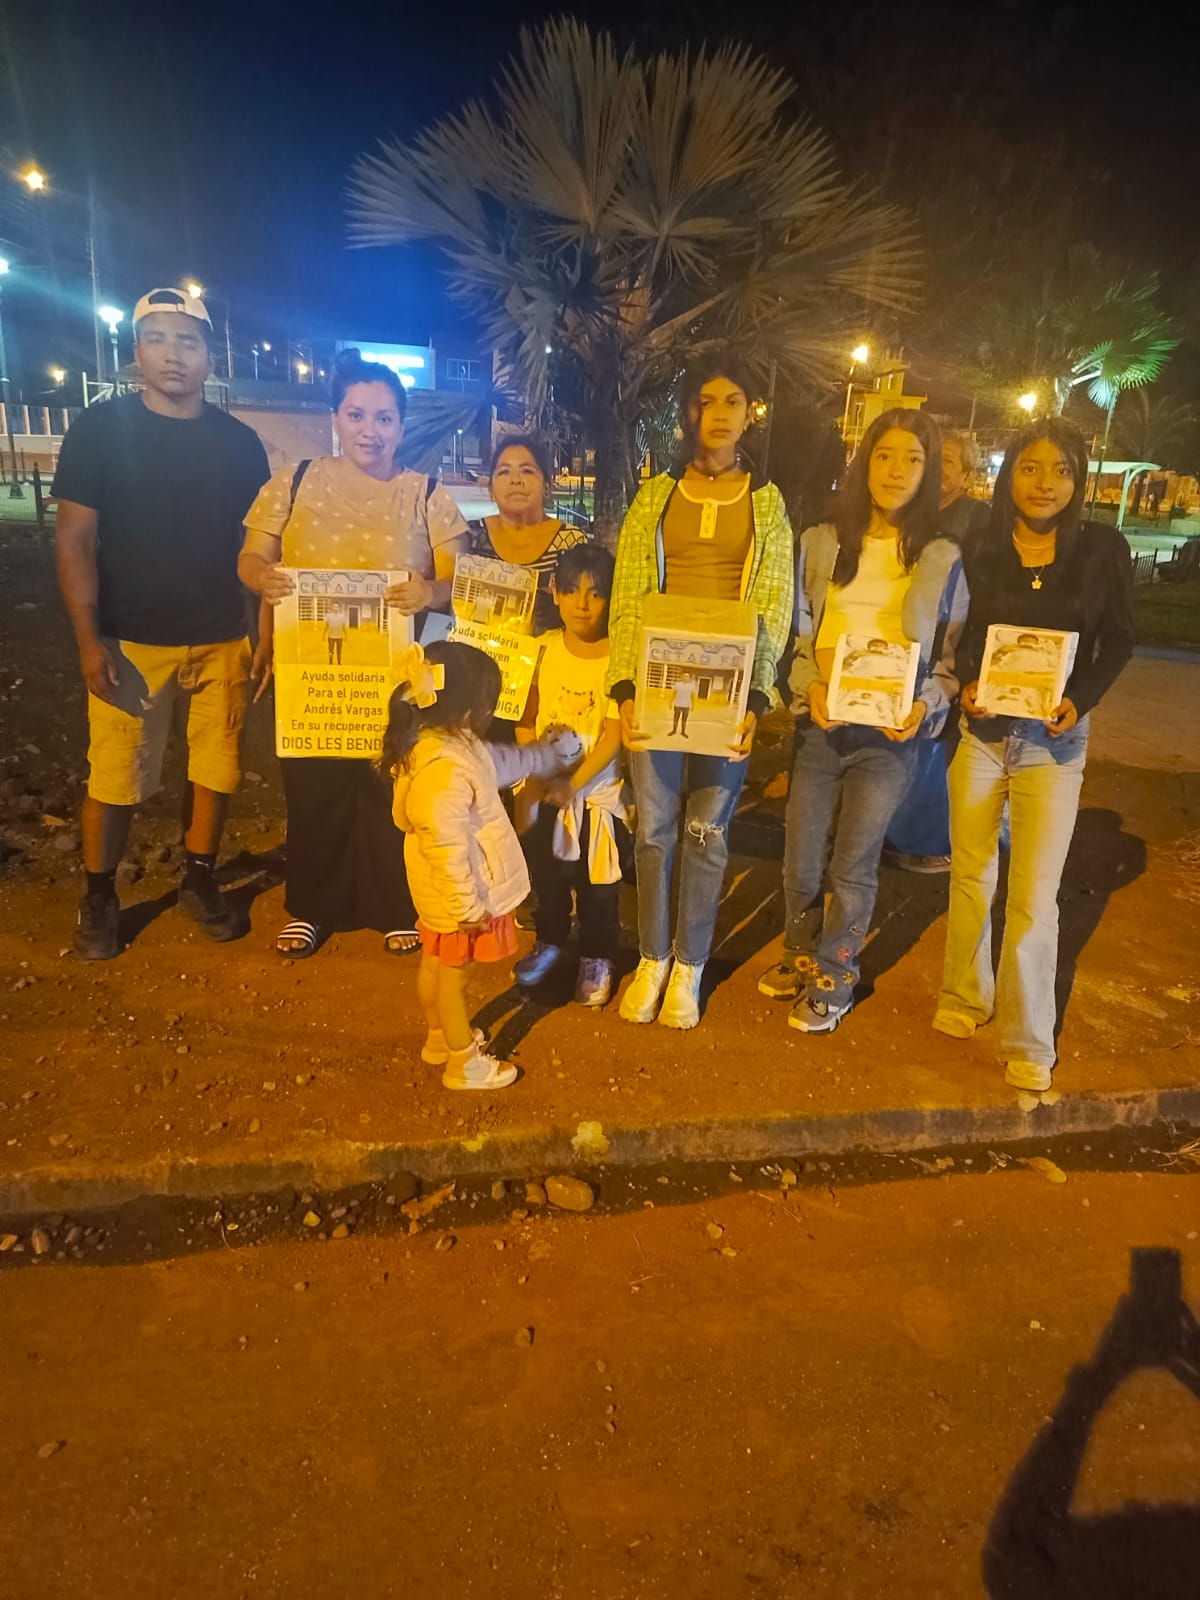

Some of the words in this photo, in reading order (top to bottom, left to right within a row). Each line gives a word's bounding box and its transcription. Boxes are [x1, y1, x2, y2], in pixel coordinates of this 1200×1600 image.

[445, 621, 475, 638] Ayuda
[301, 670, 335, 684] Ayuda
[338, 671, 385, 683] solidaria
[308, 687, 333, 698] Para
[337, 688, 347, 698] el
[350, 688, 379, 701] joven
[304, 703, 342, 714] Andrés
[345, 704, 383, 718] Vargas
[291, 719, 304, 730] En
[308, 722, 320, 731] su
[282, 736, 312, 750] DIOS
[317, 737, 342, 750] LES
[347, 737, 383, 751] BEND
